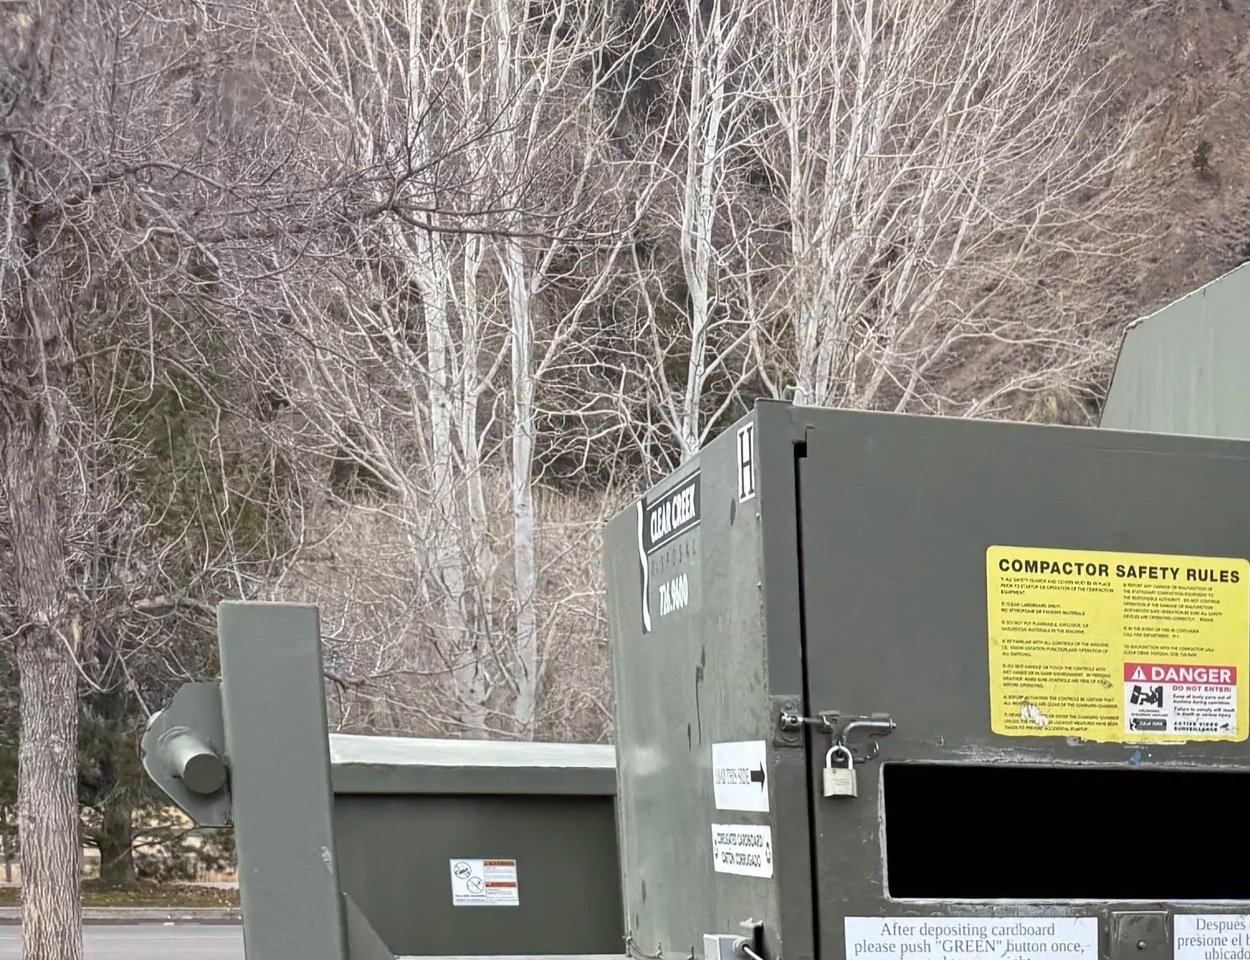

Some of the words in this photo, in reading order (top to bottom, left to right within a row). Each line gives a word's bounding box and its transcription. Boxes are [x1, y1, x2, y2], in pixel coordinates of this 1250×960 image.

[739, 426, 754, 498] H
[650, 501, 671, 543] CLEAR
[672, 483, 695, 529] CREEK
[998, 558, 1110, 577] COMPACTOR
[1115, 564, 1180, 581] SAFETY
[1186, 567, 1240, 583] RULES
[1151, 667, 1231, 683] DANGER
[880, 923, 916, 936] After
[919, 923, 987, 939] depositing
[991, 923, 1055, 936] cardboard
[1196, 918, 1246, 933] Después
[855, 940, 896, 956] please
[900, 940, 931, 956] push
[936, 940, 1002, 953] "GREEN"
[1006, 940, 1047, 953] button
[1051, 942, 1084, 954] once,
[1178, 935, 1228, 949] presione
[1231, 934, 1242, 947] el
[1204, 948, 1250, 960] ubicado
